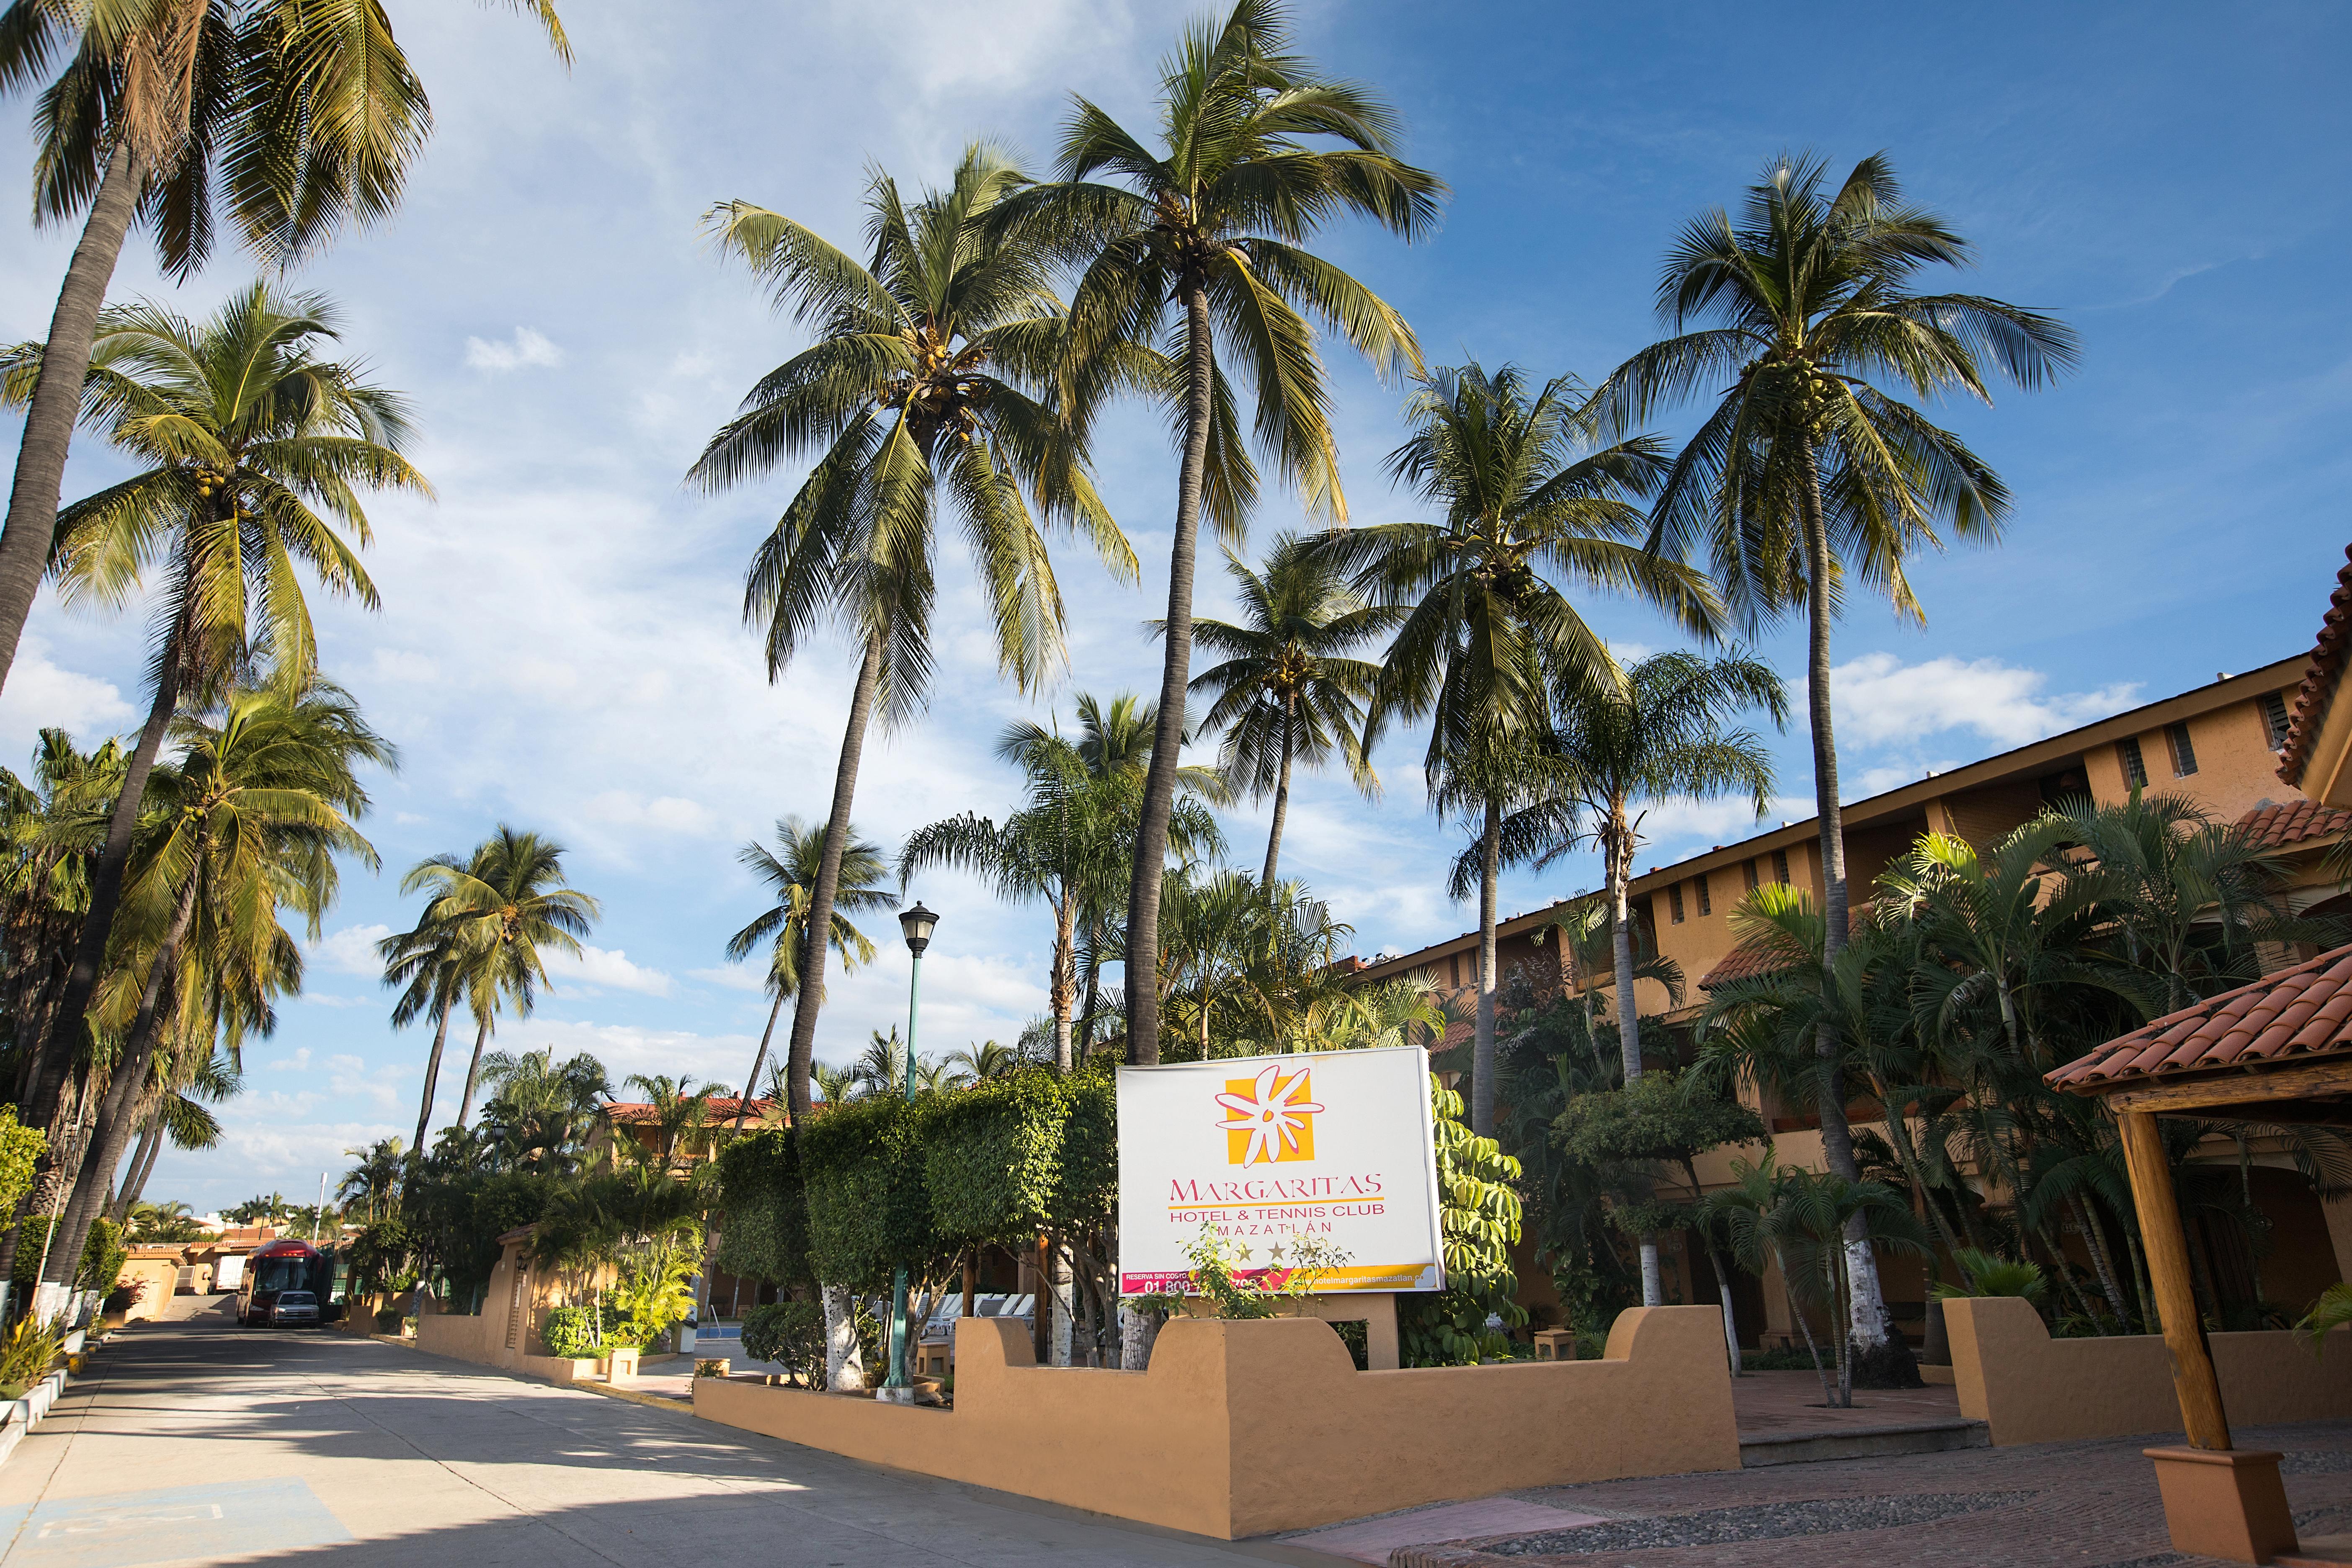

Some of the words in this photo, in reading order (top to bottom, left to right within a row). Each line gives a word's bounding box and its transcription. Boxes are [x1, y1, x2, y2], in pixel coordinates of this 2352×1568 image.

[1170, 1174, 1381, 1202] MARGARITAS
[1171, 1211, 1232, 1222] HOTEL
[1238, 1210, 1249, 1220] &
[1255, 1207, 1326, 1220] TENNIS
[1333, 1204, 1384, 1217] CLUB
[1218, 1220, 1331, 1236] MAZATLÁN
[1145, 1281, 1159, 1293] 01
[1166, 1280, 1190, 1293] 800
